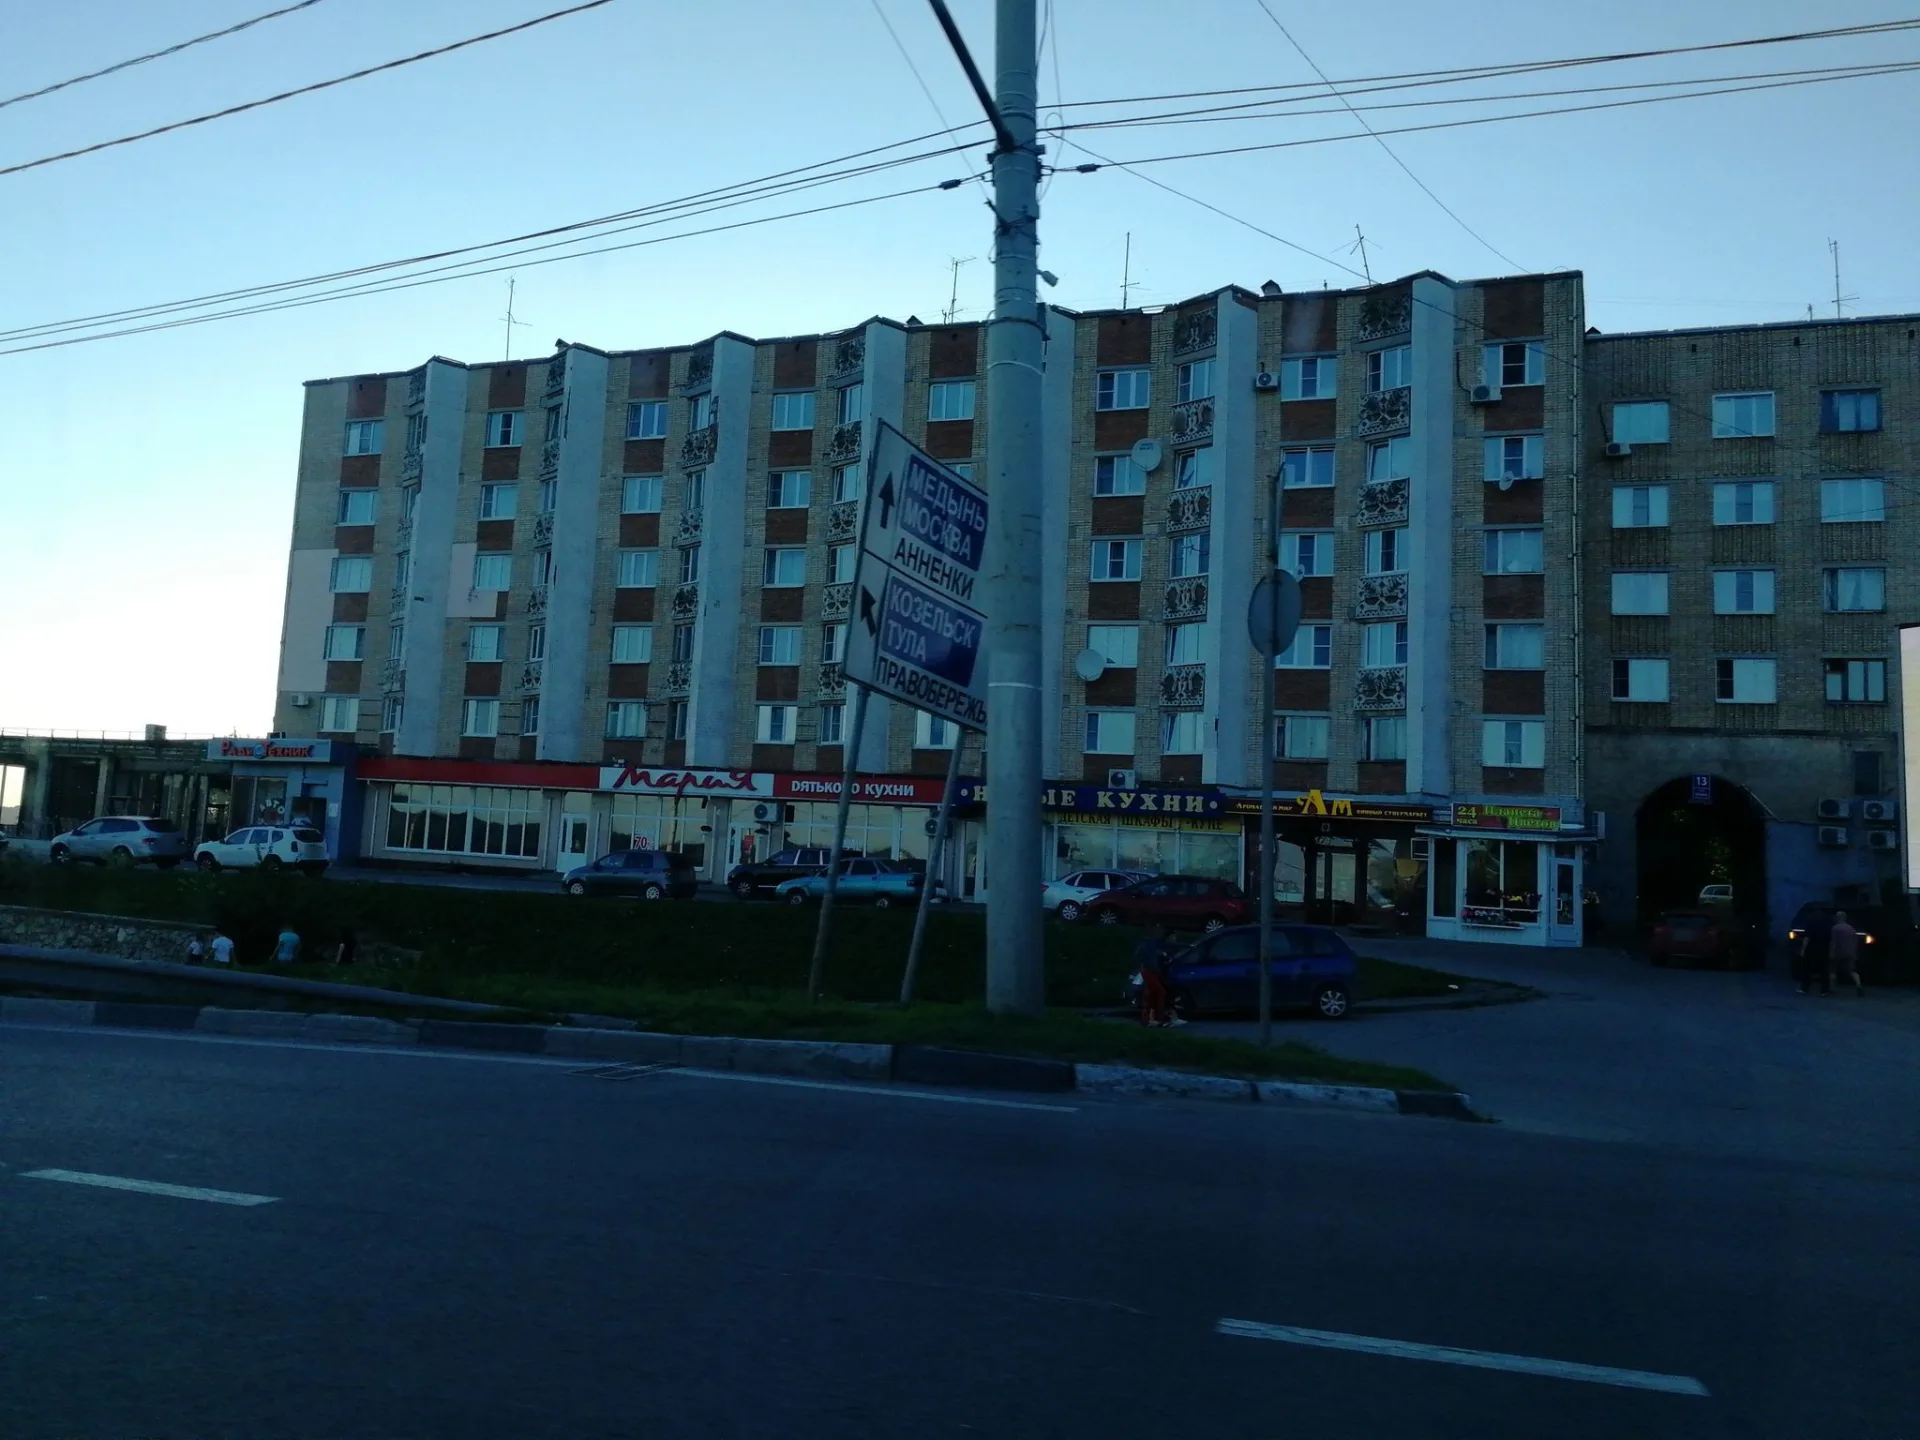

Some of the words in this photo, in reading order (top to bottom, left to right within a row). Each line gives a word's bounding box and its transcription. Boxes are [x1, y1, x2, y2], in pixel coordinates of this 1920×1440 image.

[909, 463, 986, 533] МЕДЫНЬ
[903, 497, 973, 561] МОСКВА
[894, 537, 974, 601] АННЕНКИ
[886, 619, 927, 663] ТУЛА
[889, 583, 978, 649] КОЗЕЛЬСК
[875, 656, 988, 724] ПРАВОБЕРЕЖЬ
[1096, 790, 1205, 812] КУХНИ
[1695, 776, 1708, 786] 13
[1059, 811, 1111, 826] ДЕТСКАЯ
[1122, 814, 1174, 829] ШКАФЫ
[1457, 806, 1477, 818] 24
